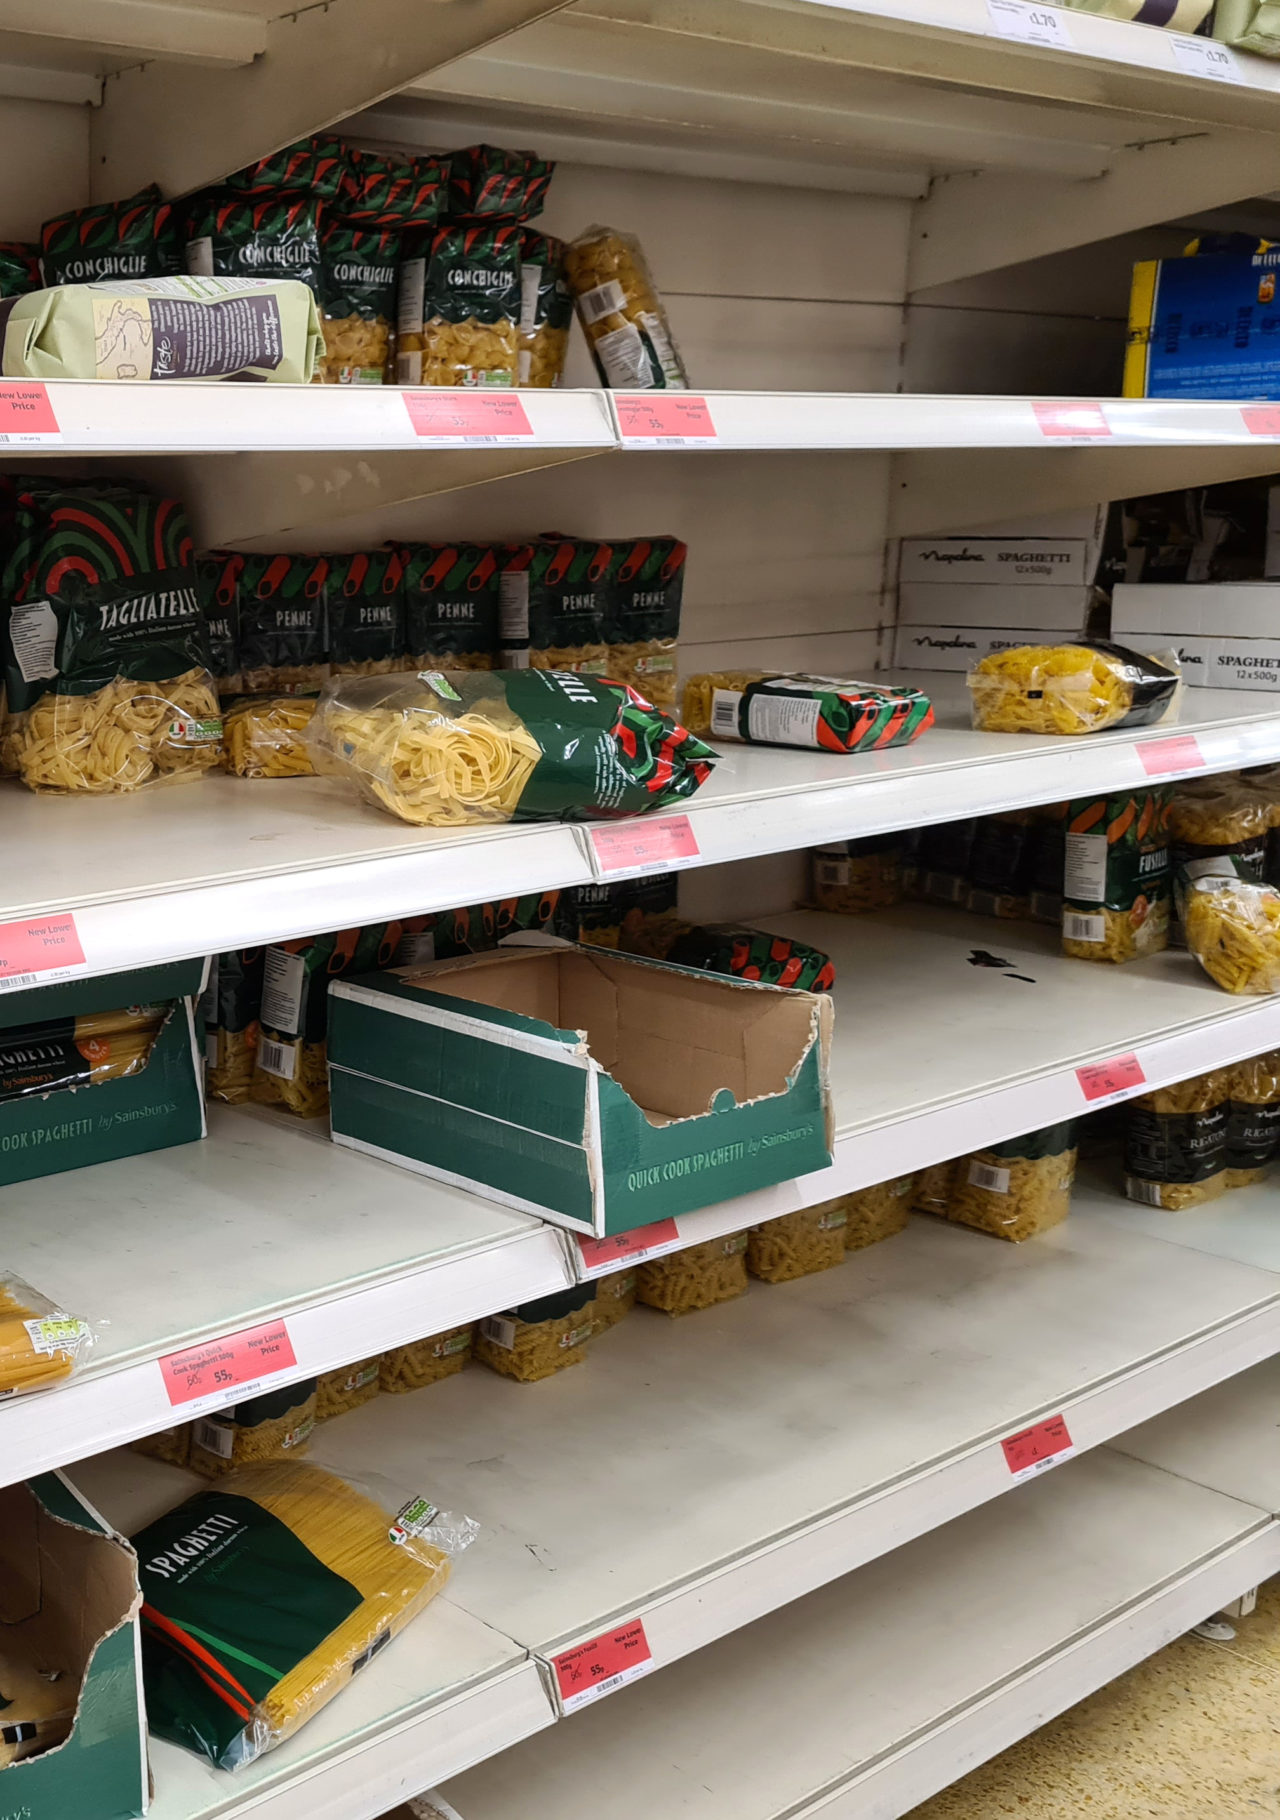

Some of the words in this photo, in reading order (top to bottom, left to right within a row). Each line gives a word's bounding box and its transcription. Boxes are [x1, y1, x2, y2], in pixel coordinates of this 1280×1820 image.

[65, 255, 146, 280] CONCHIGLIE
[334, 264, 394, 283] CONCHIGLIE
[12, 402, 35, 410] Price
[918, 548, 985, 564] Napolina
[997, 552, 1071, 564] SPAGHETTI
[562, 593, 595, 610] PENNE
[632, 591, 665, 607] PENNE
[100, 587, 200, 631] TAGLIATELLE
[360, 606, 392, 623] PENNE
[438, 602, 474, 618] PENNE
[276, 610, 312, 626] PENNE
[914, 635, 977, 651] Napolina
[577, 886, 609, 903] PENNE
[28, 927, 47, 937] New
[44, 937, 65, 946] Price
[89, 1040, 100, 1051] 4
[2, 1079, 11, 1089] by
[12, 1073, 54, 1086] Sainsbury's
[32, 1118, 93, 1146] SPAGHETTI
[98, 1115, 113, 1131] by
[114, 1102, 177, 1124] Sainsbury's
[628, 1166, 660, 1192] QUICK
[663, 1158, 691, 1181] COOK
[693, 1143, 744, 1172] SPAGHETTI
[747, 1139, 761, 1155] by
[762, 1124, 814, 1148] Sainsbury's
[248, 1339, 264, 1349] New
[264, 1331, 286, 1343] Lower
[171, 1352, 205, 1368] Sainsbury's
[206, 1346, 223, 1357] Quick
[261, 1345, 280, 1356] Price
[173, 1366, 189, 1375] Cook
[189, 1356, 218, 1371] Spaghetti
[219, 1352, 234, 1362] 500g
[214, 1369, 233, 1383] 55p
[145, 1514, 239, 1578] SPAGHETTI
[624, 1640, 638, 1649] Price
